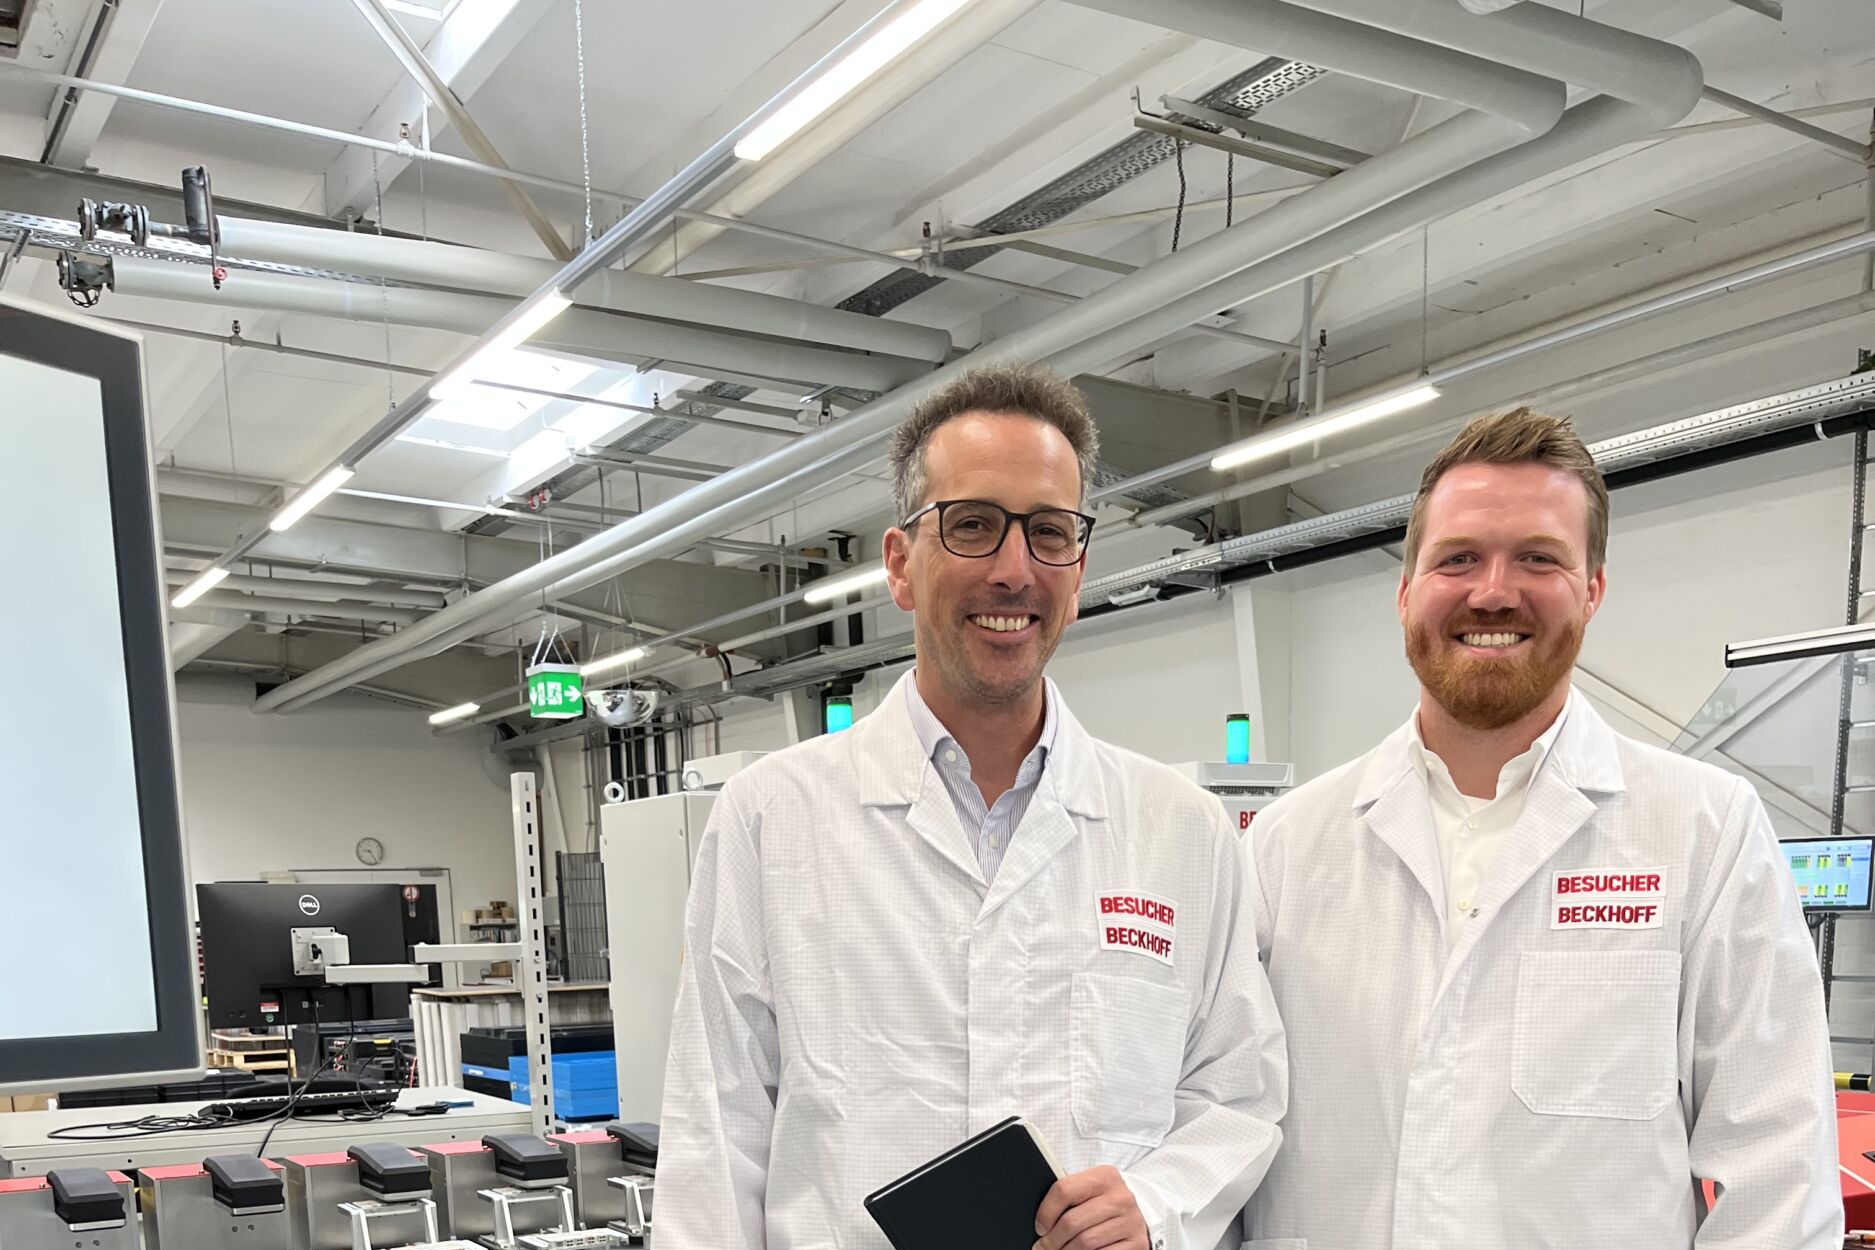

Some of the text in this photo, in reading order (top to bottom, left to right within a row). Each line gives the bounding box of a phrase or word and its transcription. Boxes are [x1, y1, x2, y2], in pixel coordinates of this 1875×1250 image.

[1557, 874, 1660, 894] BESUCHER
[1100, 896, 1174, 927] BESUCHER
[1558, 905, 1657, 923] BECKHOFF
[1106, 927, 1172, 957] BECKHOFF
